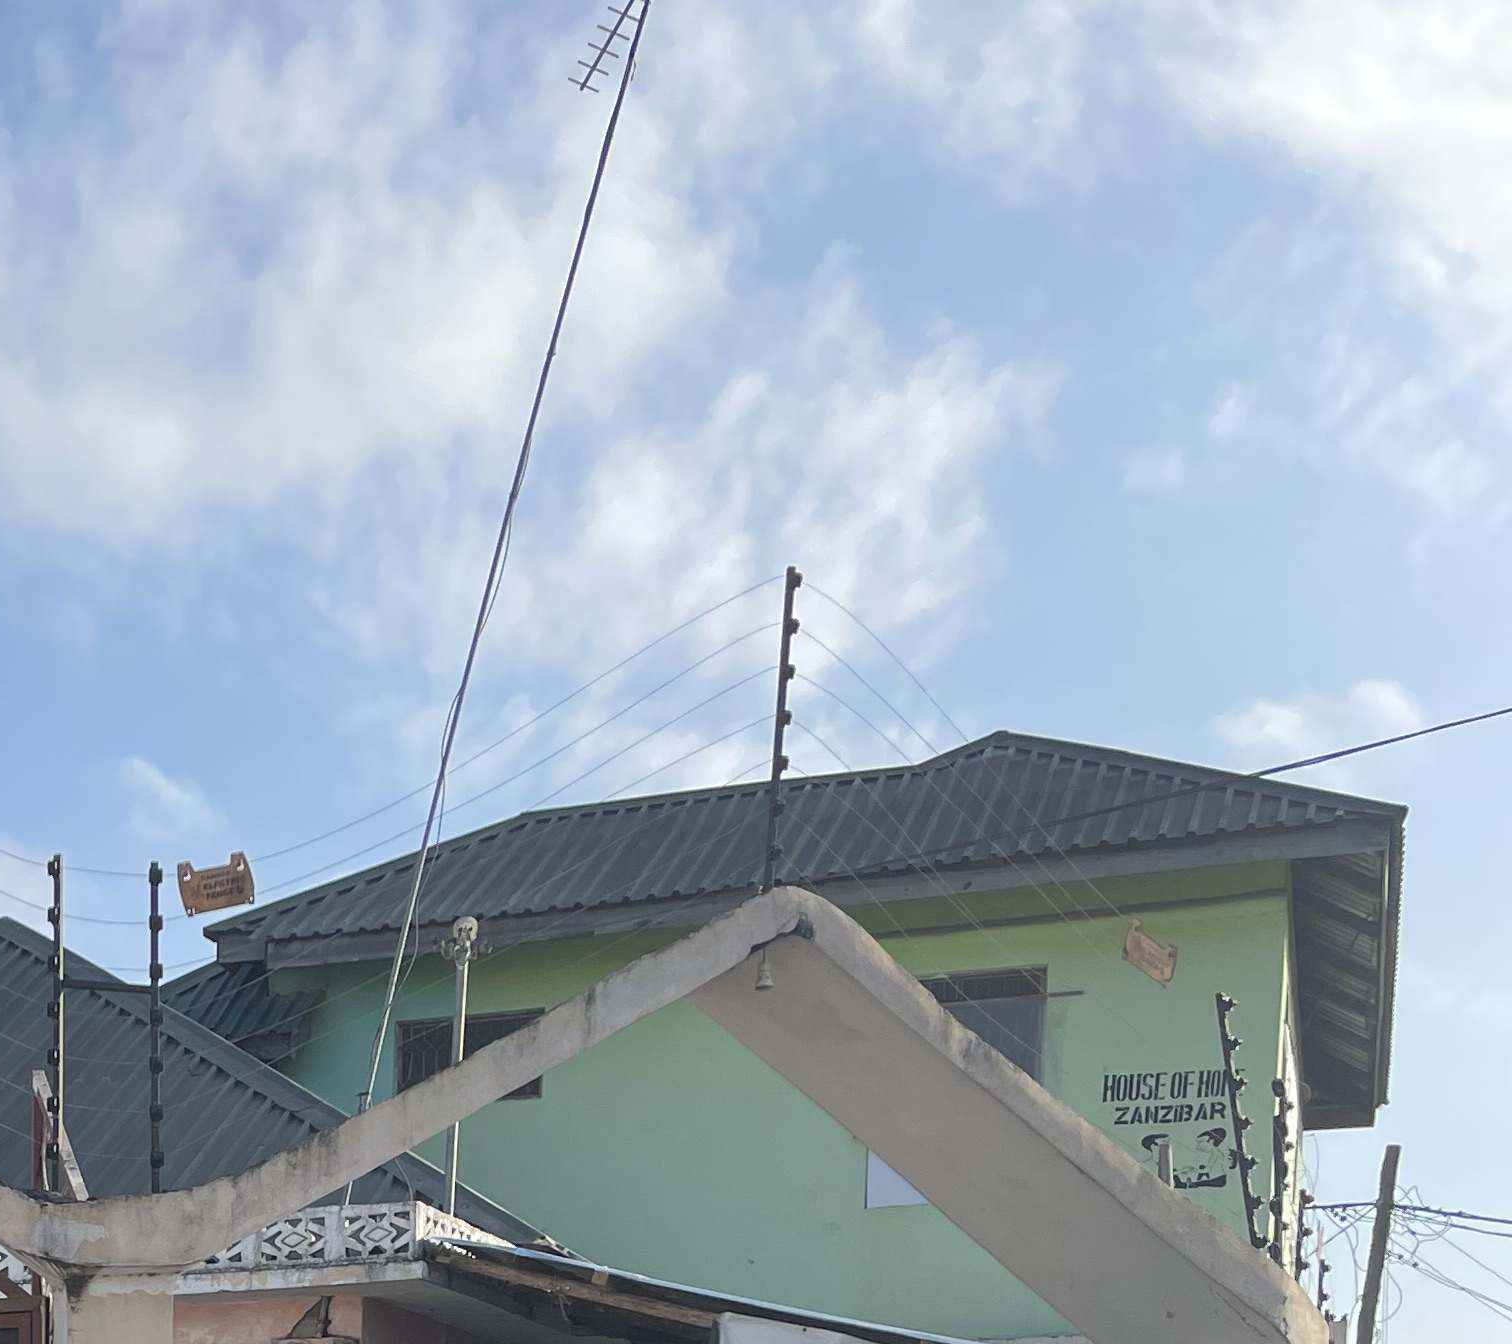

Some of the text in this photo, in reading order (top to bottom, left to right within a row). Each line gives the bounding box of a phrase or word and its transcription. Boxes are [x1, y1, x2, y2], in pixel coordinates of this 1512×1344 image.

[1102, 1072, 1168, 1103] HOUSE
[1170, 1070, 1195, 1099] OF
[1114, 1101, 1227, 1125] ZANZIBAR
